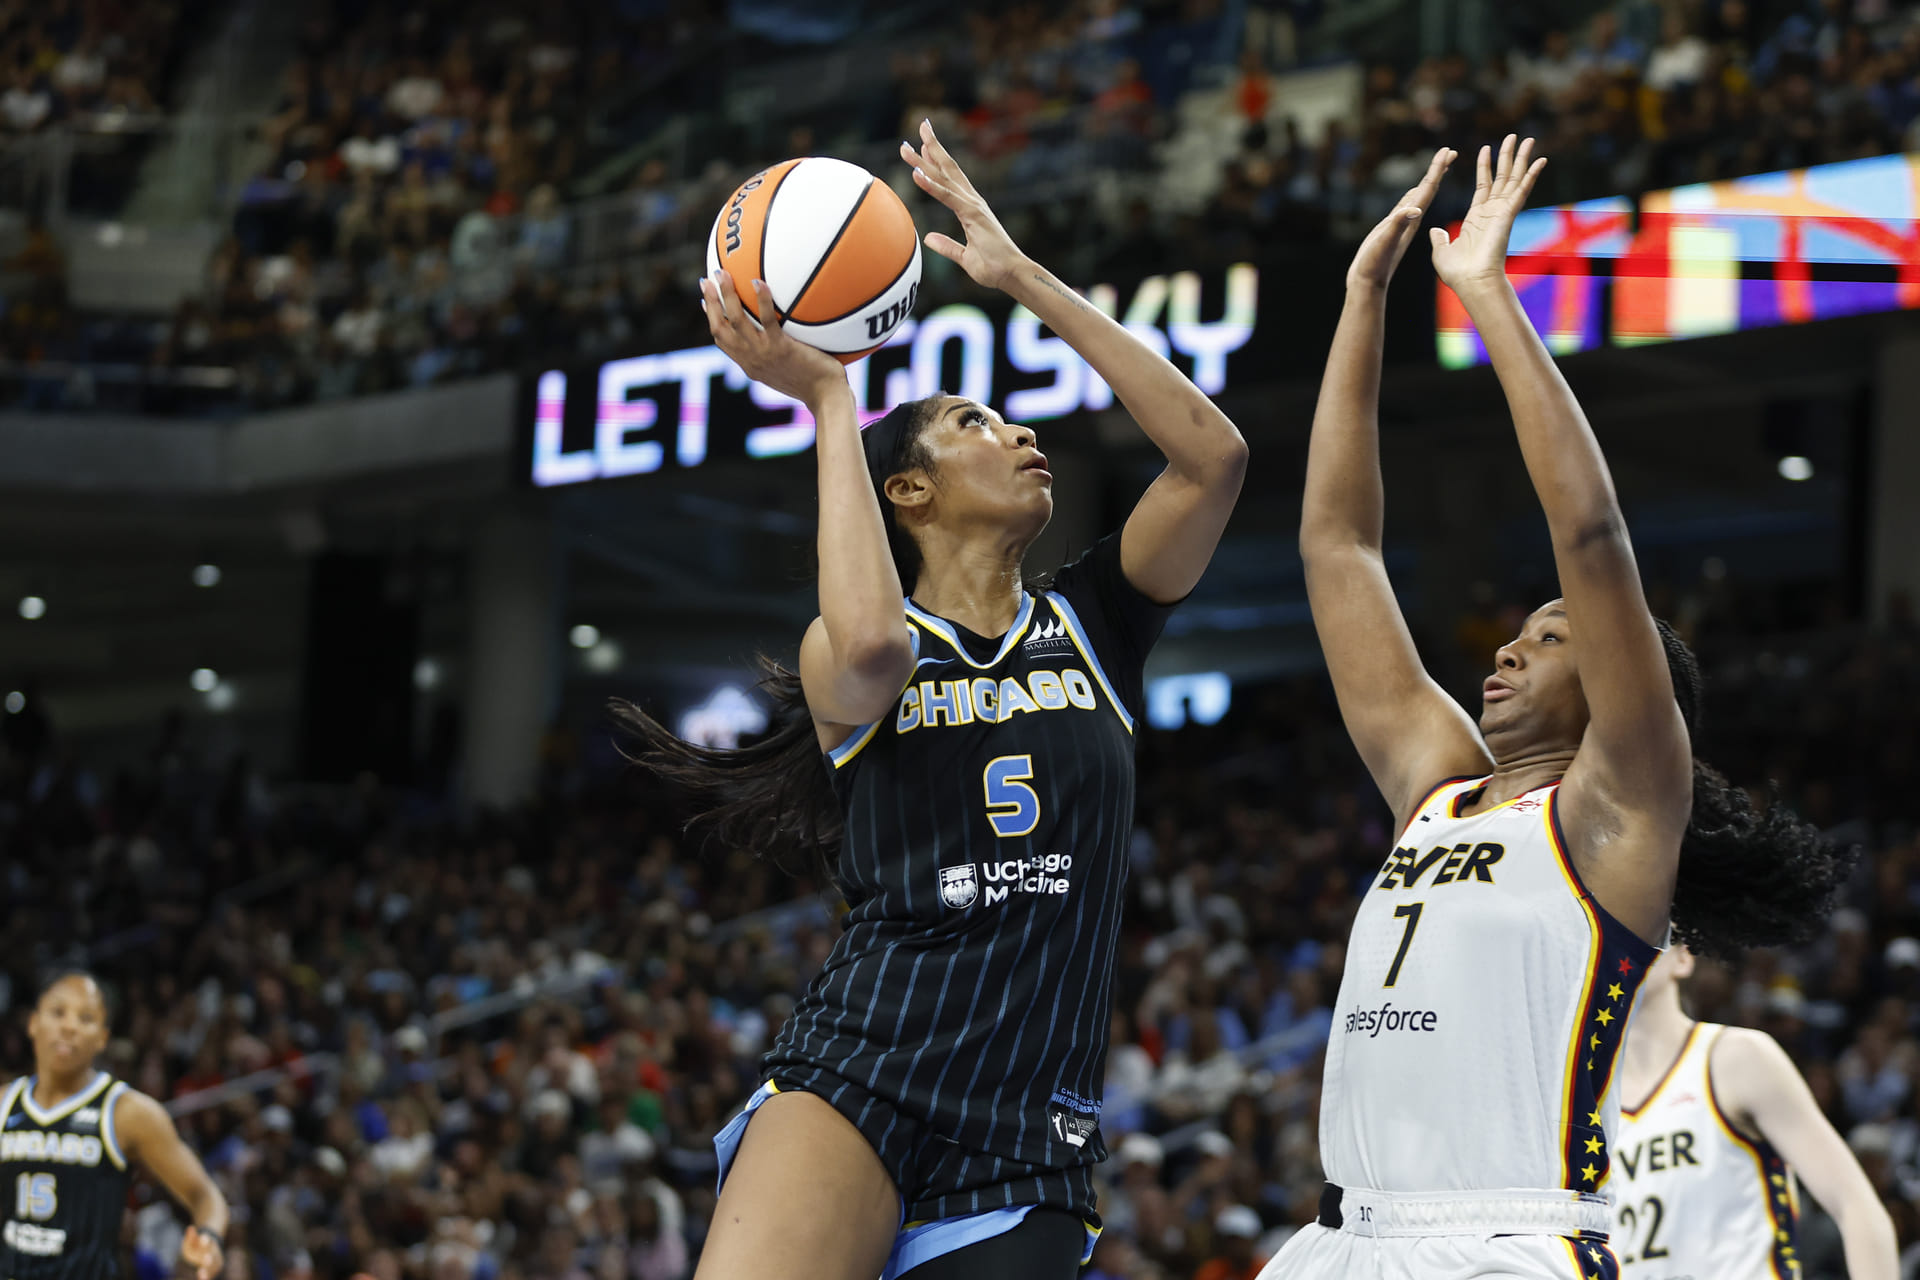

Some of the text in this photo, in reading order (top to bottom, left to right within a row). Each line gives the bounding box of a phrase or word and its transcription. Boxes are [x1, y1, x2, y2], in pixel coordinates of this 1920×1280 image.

[864, 280, 921, 340] Wil
[531, 343, 818, 488] LET'S
[1024, 640, 1073, 652] MAGELLAN
[896, 668, 1097, 735] CHICAGO
[982, 753, 1041, 838] 5
[982, 853, 1073, 882] UChago
[1381, 901, 1425, 989] 7
[0, 1130, 103, 1168] HICAGO
[1616, 1129, 1701, 1182] VER
[16, 1171, 58, 1222] 15
[1618, 1194, 1671, 1265] 22
